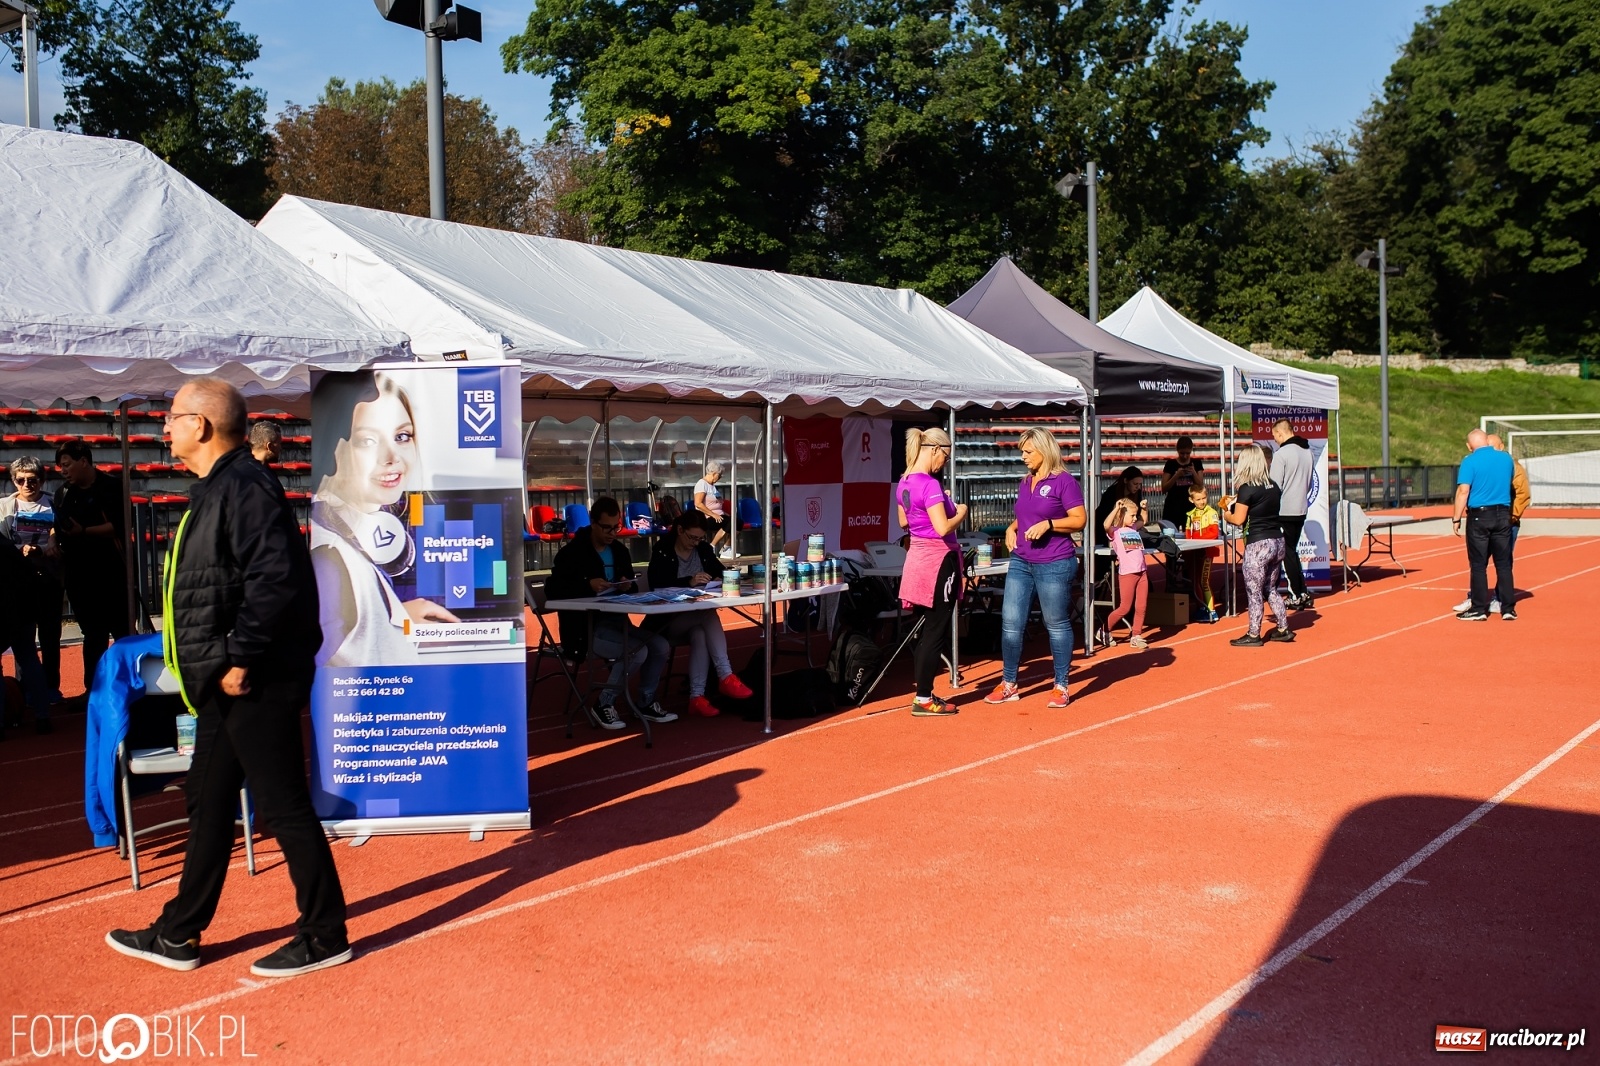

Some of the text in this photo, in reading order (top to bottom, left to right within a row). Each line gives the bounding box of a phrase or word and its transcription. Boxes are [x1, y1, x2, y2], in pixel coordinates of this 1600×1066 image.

[1138, 378, 1190, 395] www.raciborz.pl
[1251, 379, 1262, 389] TEB
[1263, 380, 1285, 393] Edukacja
[463, 389, 496, 403] TEB
[1257, 407, 1322, 415] STOWARZYSZENIE
[1257, 415, 1316, 424] PODTRÓW
[1257, 424, 1323, 433] POOGÓW
[861, 432, 871, 453] R
[423, 535, 494, 548] Rekrutacja
[423, 549, 469, 563] trwa!
[415, 627, 500, 638] Szkoły policealne #1
[333, 675, 414, 686] Racibórz, Rynek 6a
[333, 687, 405, 697] tel. 32 661 42 80
[333, 711, 446, 724] Makijaż permanentny
[333, 723, 507, 740] Dietetyka i zaburzenia odżywiania
[333, 738, 499, 753] Pomoc nauczyciela przedszkola
[333, 755, 448, 771] Programowanie JAVA
[333, 771, 422, 784] Wizaż i stylizacja
